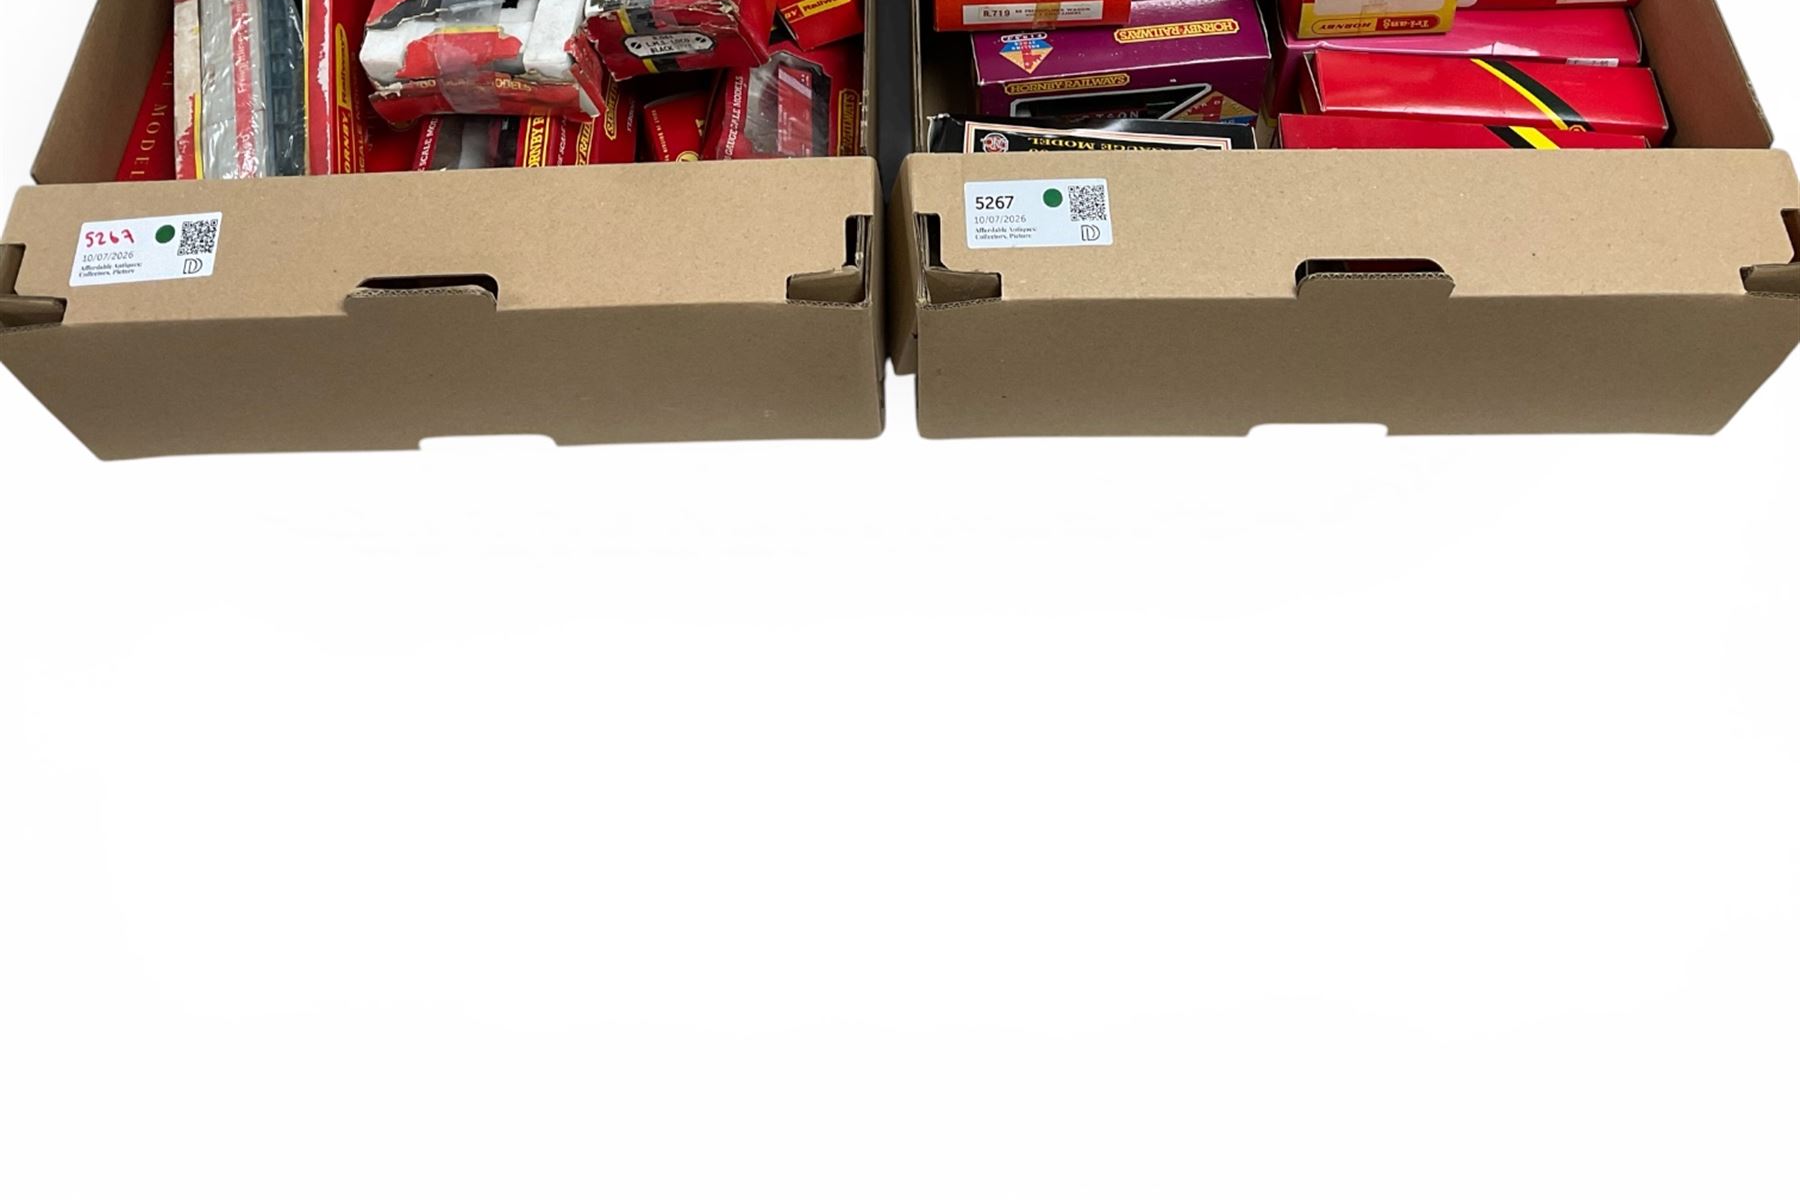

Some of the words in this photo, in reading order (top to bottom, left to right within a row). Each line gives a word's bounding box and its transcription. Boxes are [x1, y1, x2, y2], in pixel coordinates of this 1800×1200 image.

[983, 10, 1010, 18] R.719
[1120, 26, 1180, 40] RAILWAYS
[1184, 20, 1234, 35] HORNBY
[1320, 22, 1372, 30] HORNBY
[729, 75, 747, 107] MODELS
[1011, 79, 1063, 93] HORNBY
[1064, 74, 1126, 89] RAILWAYS
[130, 103, 168, 179] MODEL
[343, 111, 351, 174] ORNBY
[724, 127, 738, 155] GAUGE
[1028, 137, 1094, 150] MODEL
[417, 137, 433, 167] SCALE
[975, 195, 1015, 210] 5267
[974, 215, 1027, 225] 10/07/2026
[975, 226, 1007, 234] Affordable
[85, 229, 135, 248] 5267
[82, 251, 134, 263] 10/07/2026
[80, 263, 112, 272] Affordable
